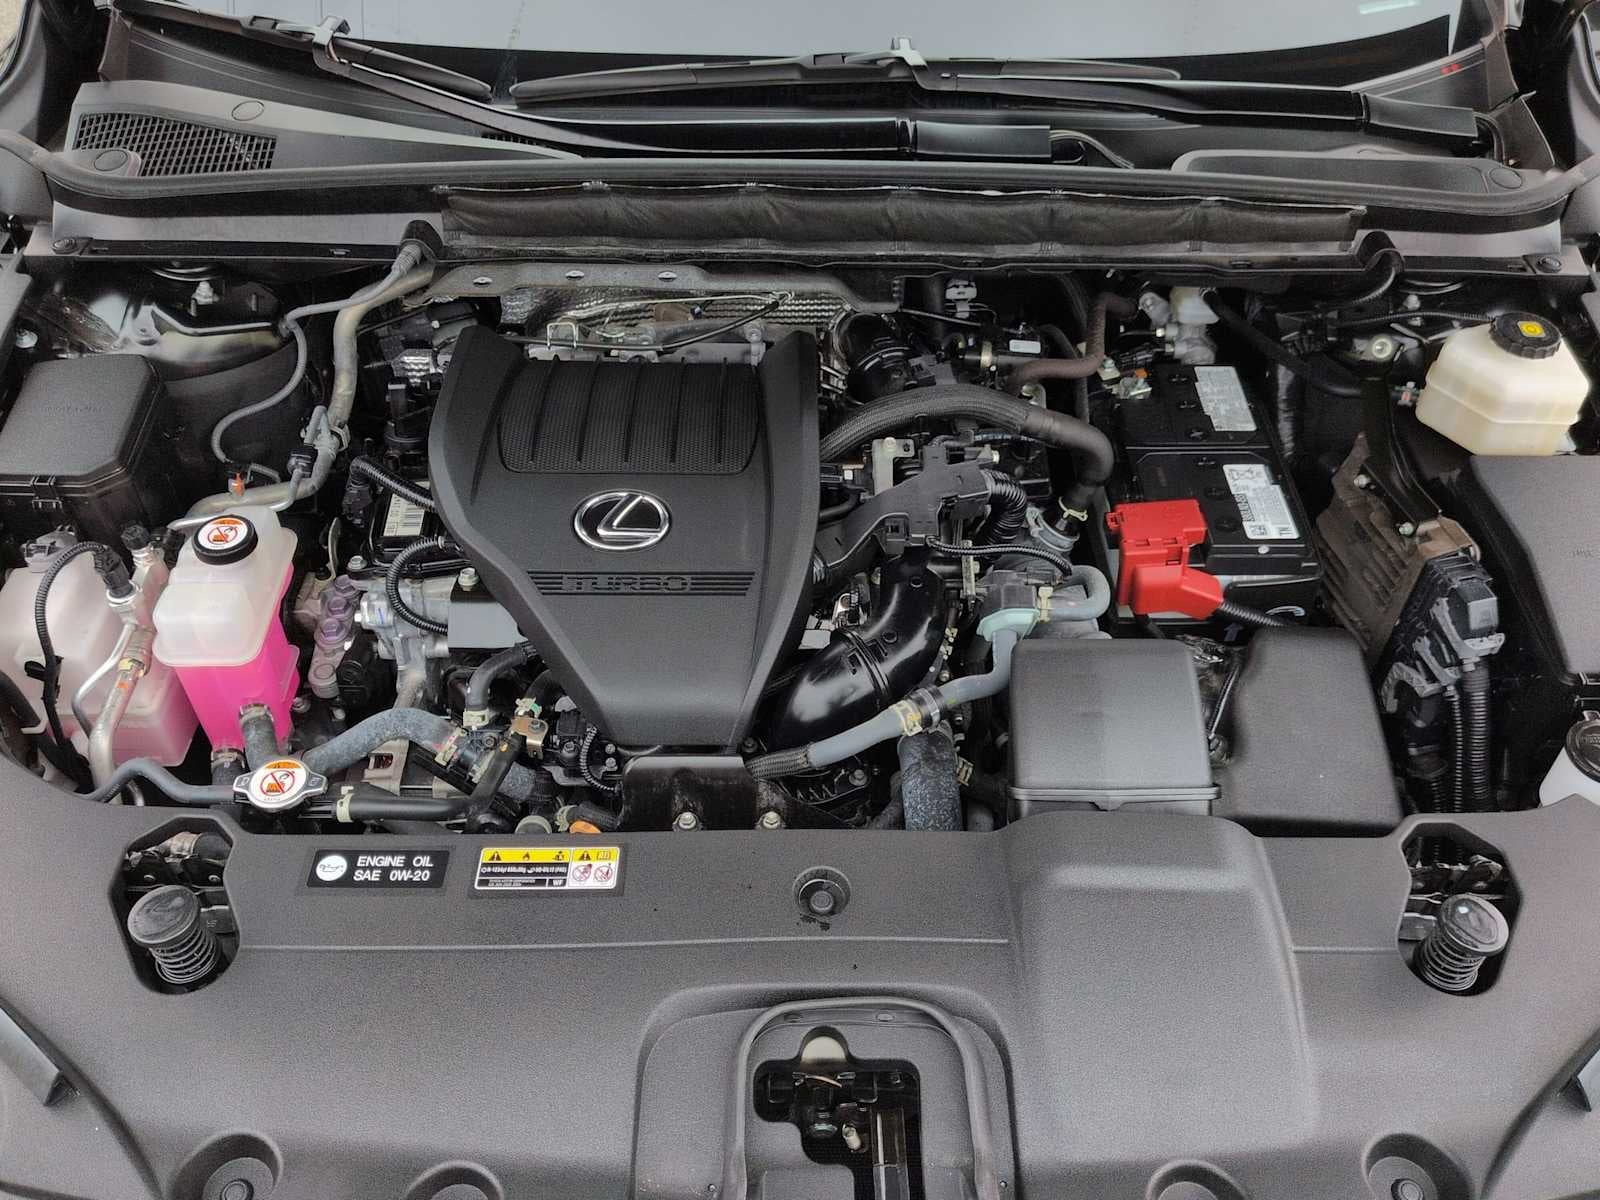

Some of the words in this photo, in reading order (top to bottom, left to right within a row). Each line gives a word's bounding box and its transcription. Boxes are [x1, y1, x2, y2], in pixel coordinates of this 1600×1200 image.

[566, 576, 688, 591] TURBO
[356, 856, 405, 867] ENGINE
[412, 856, 434, 867] OIL
[353, 869, 382, 881] SAE
[389, 869, 430, 881] 0W-20
